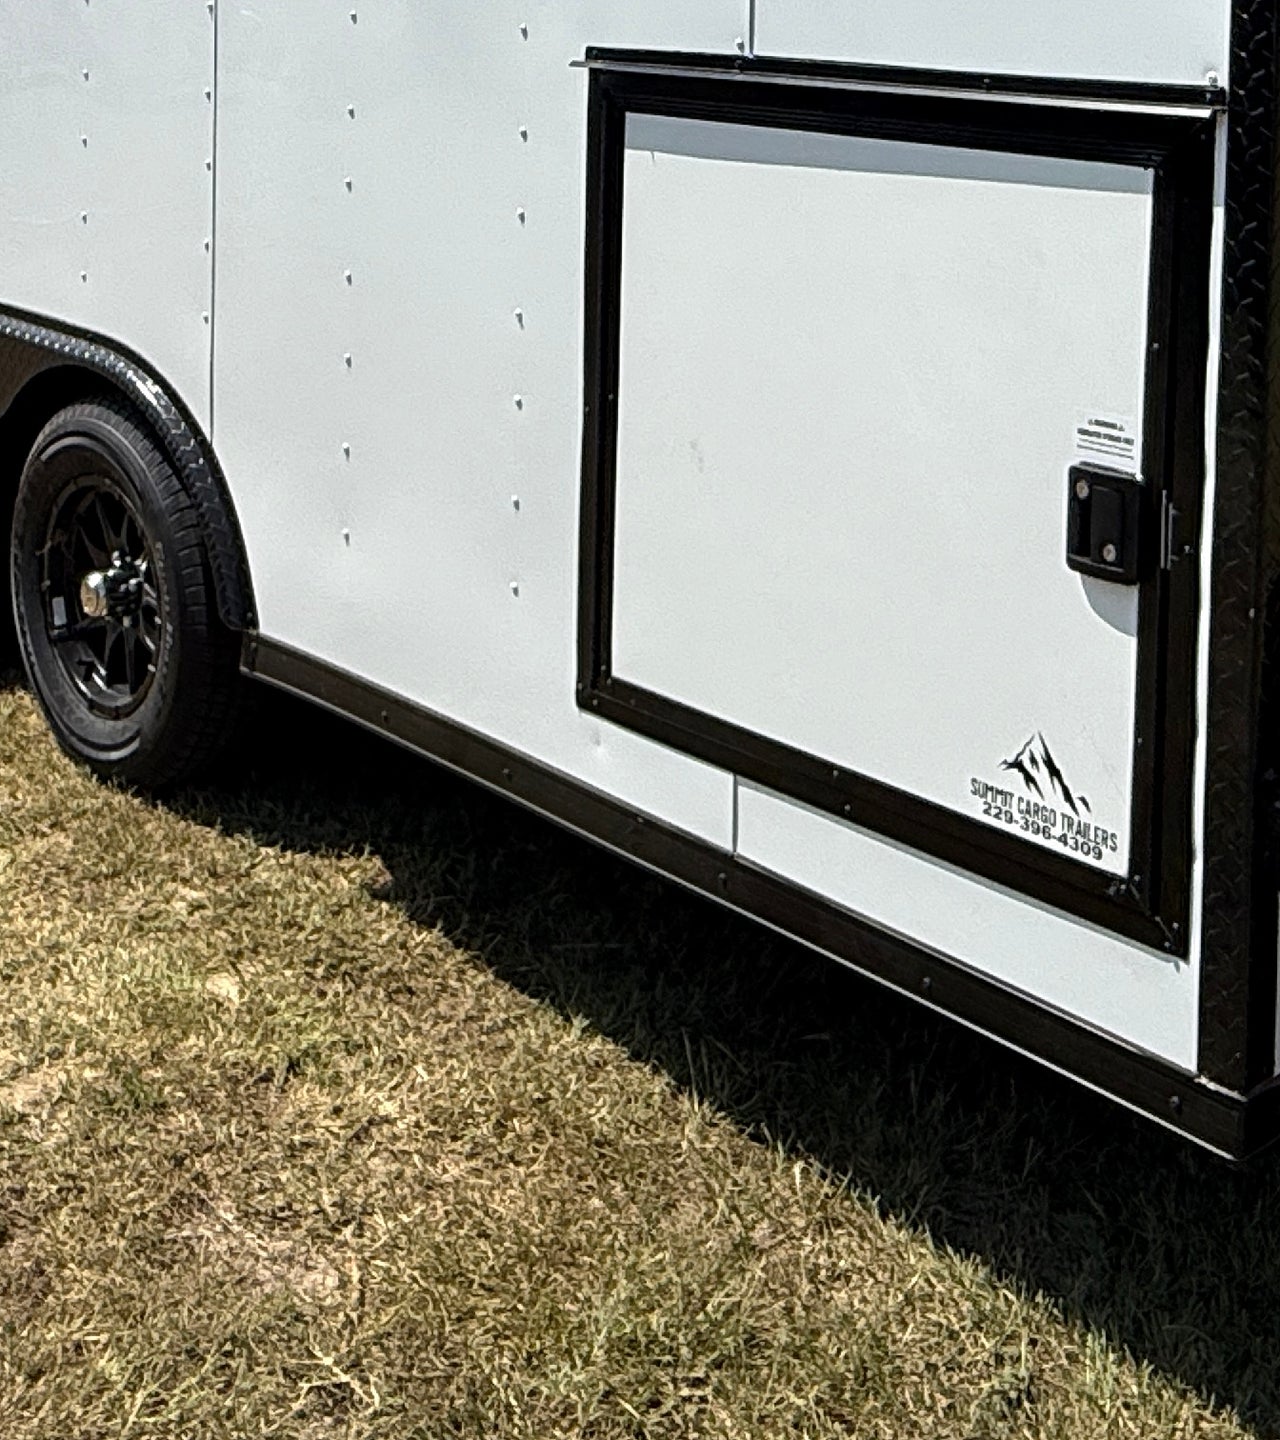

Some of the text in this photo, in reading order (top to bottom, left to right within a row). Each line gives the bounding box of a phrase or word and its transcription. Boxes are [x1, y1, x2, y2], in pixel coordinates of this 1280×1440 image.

[970, 777, 1118, 853] SUMMIT CARGO TRAILERS
[982, 801, 1103, 861] 229-396-4309
